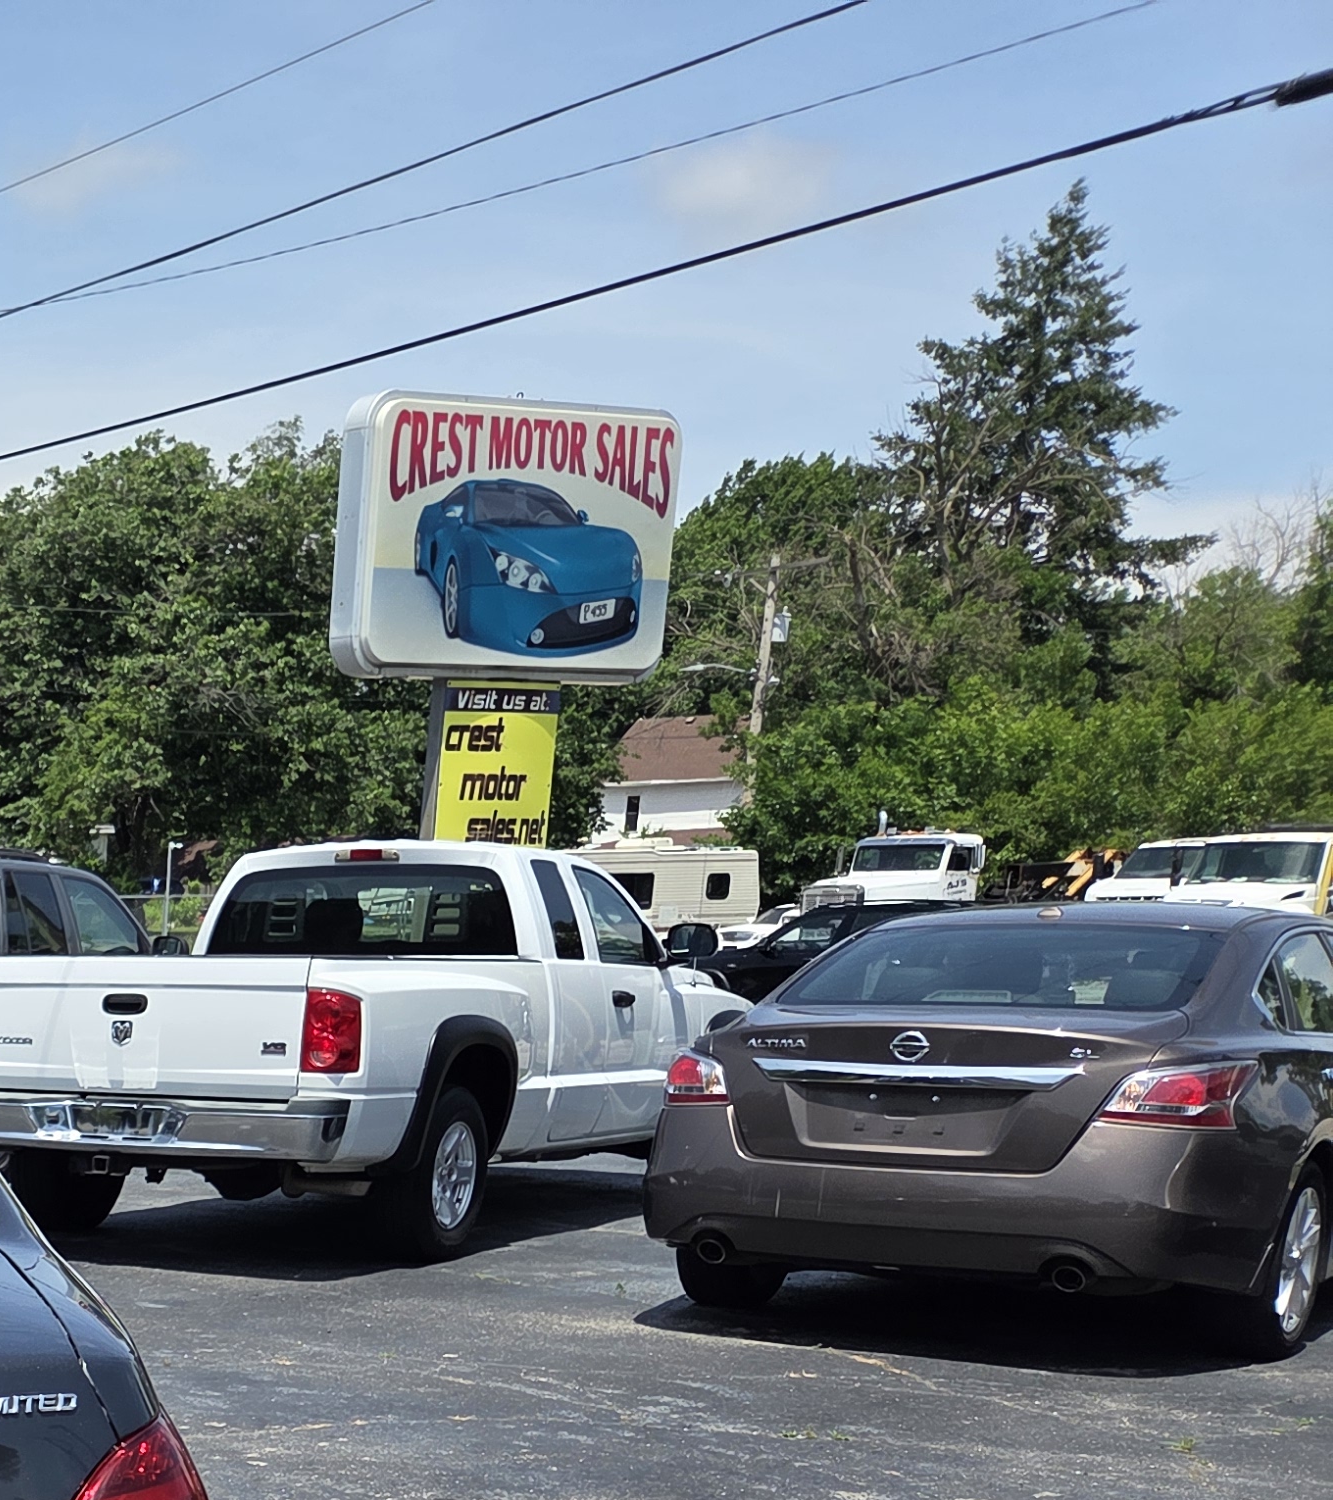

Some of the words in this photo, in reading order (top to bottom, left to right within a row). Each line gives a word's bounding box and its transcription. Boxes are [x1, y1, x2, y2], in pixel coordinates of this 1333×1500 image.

[389, 408, 484, 502] CREST
[488, 415, 587, 477] MOTOR
[594, 422, 675, 519] SALES
[457, 690, 498, 710] Visit
[502, 695, 527, 711] us
[529, 692, 550, 712] at:
[444, 717, 505, 752] crest
[459, 765, 527, 801] motor
[464, 809, 546, 846] sales.net
[746, 1037, 807, 1048] ALTIMA
